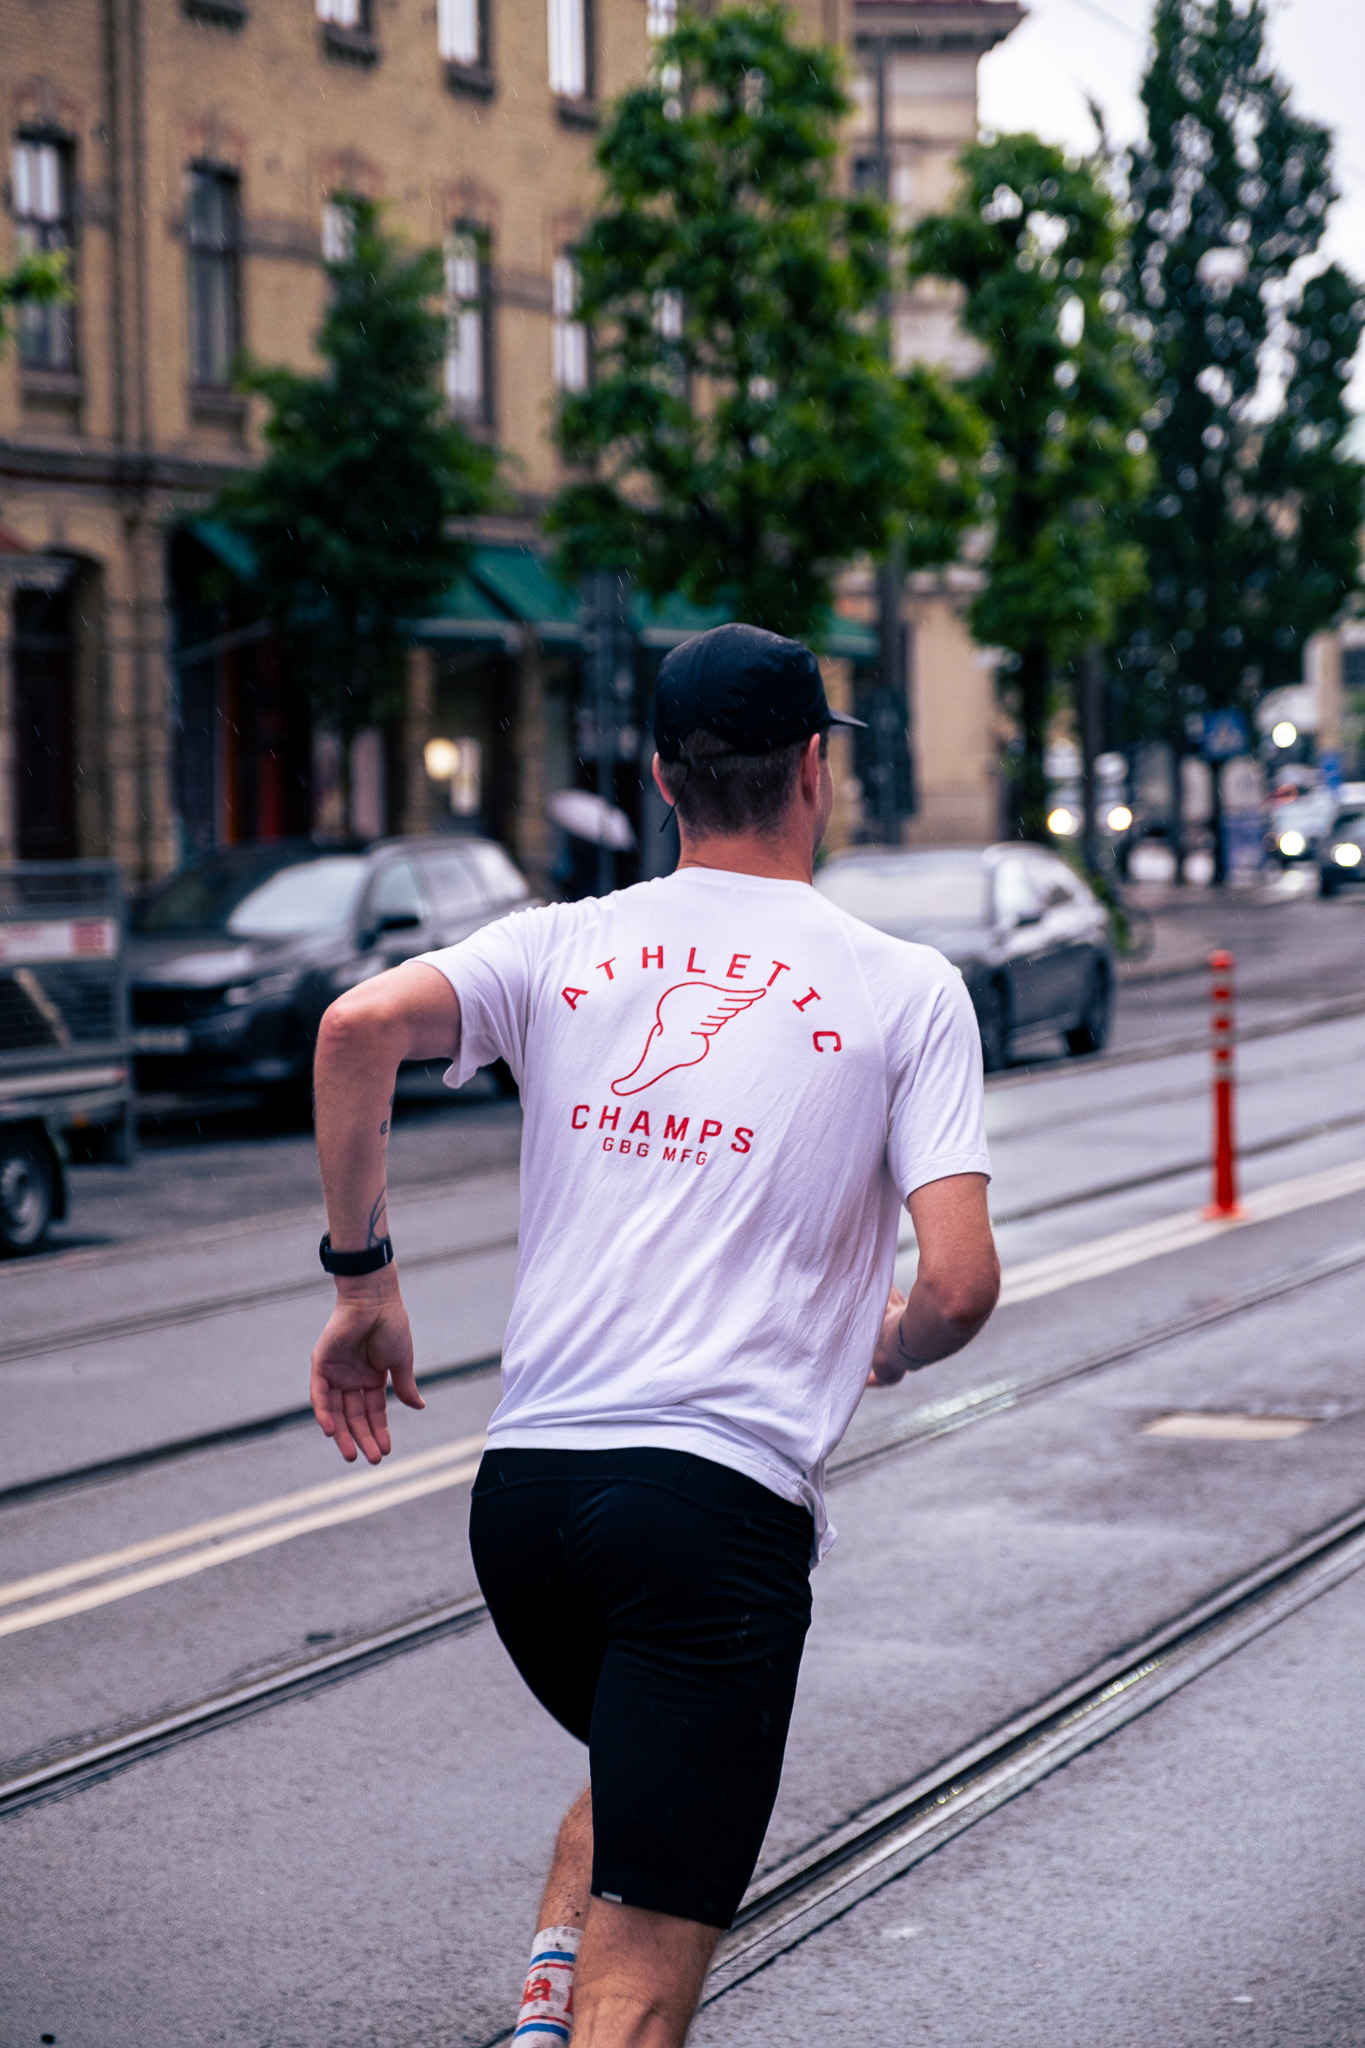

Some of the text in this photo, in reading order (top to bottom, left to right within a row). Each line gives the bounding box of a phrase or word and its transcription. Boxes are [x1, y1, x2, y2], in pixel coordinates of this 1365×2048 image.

[561, 945, 843, 1053] ATHLETIC
[571, 1104, 755, 1154] CHAMPS
[602, 1137, 708, 1166] GBG MFG
